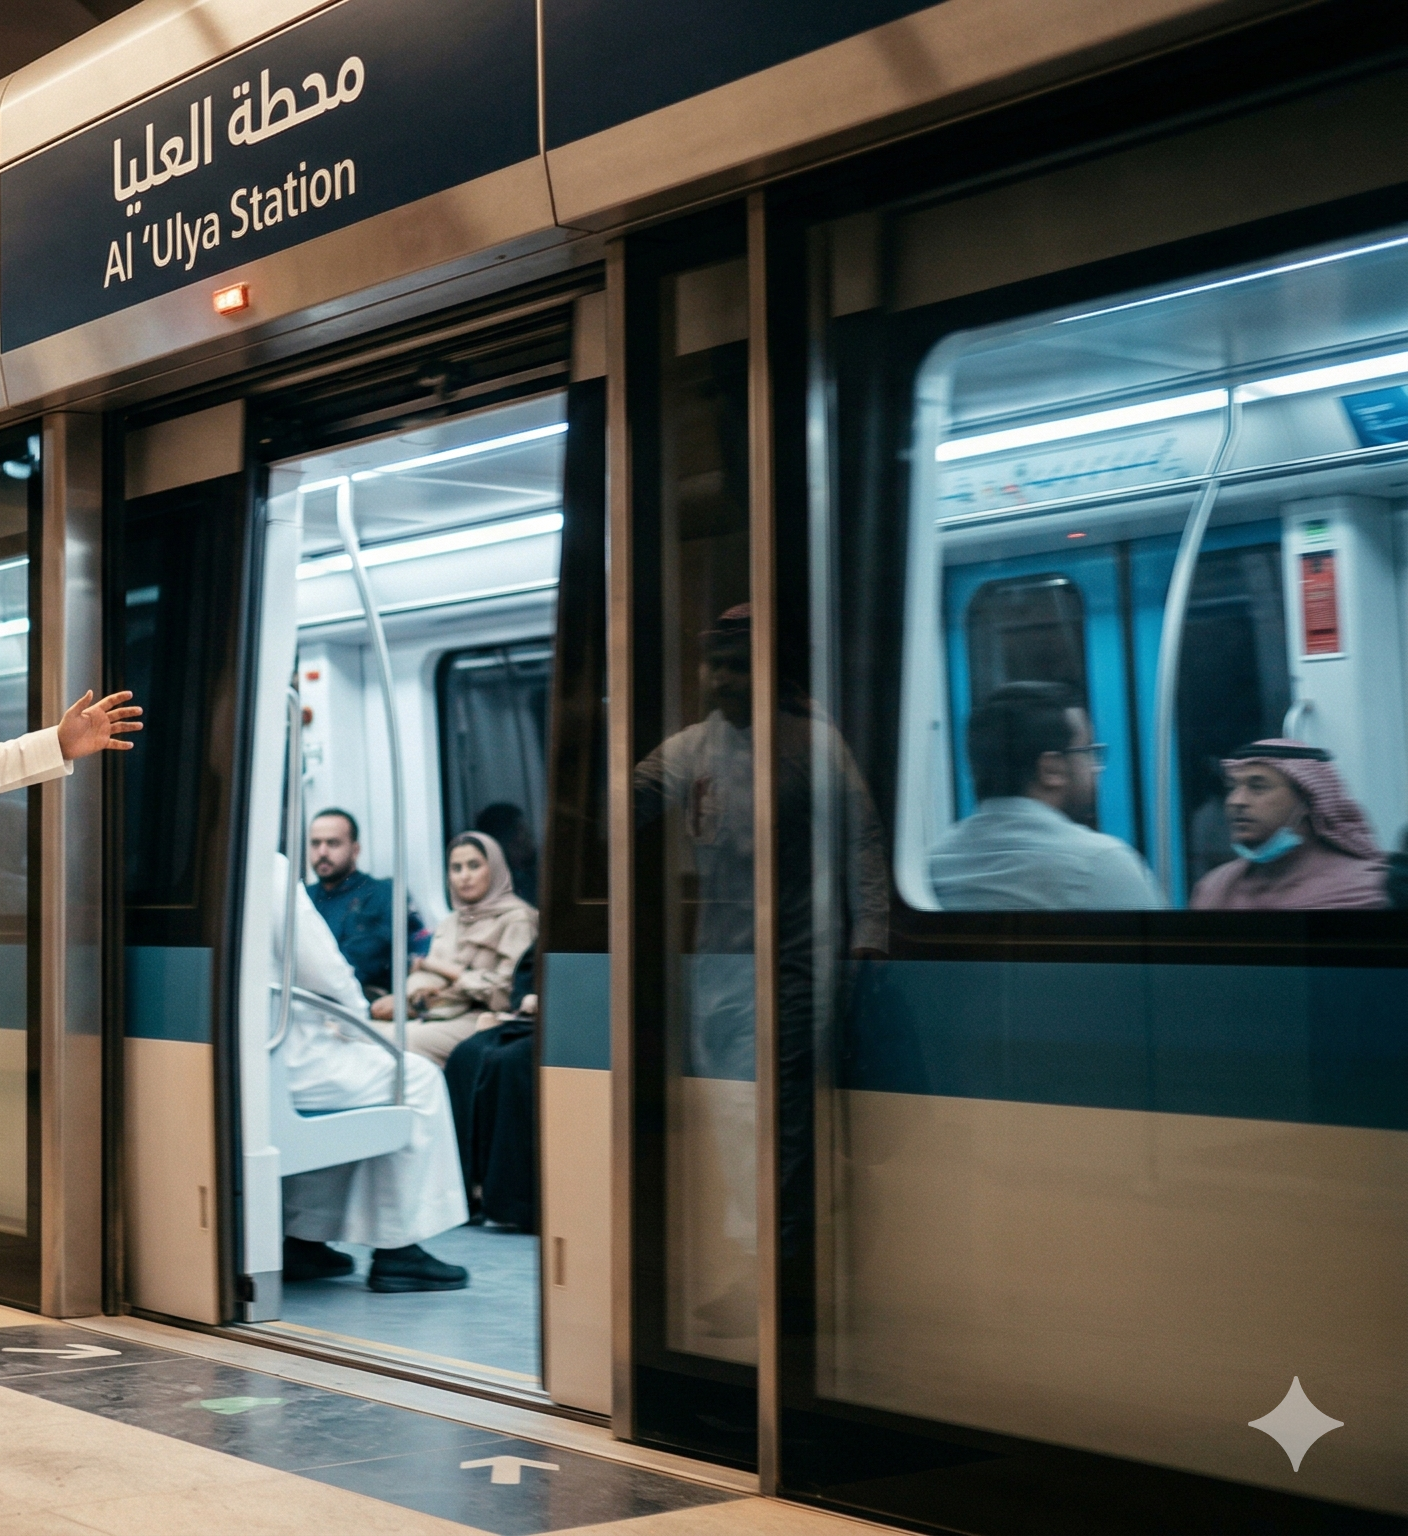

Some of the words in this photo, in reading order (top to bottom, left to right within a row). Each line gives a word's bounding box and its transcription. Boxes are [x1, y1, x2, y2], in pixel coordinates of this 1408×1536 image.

[113, 95, 212, 217] العليا
[228, 56, 365, 146] محطة
[103, 231, 133, 289] Al
[230, 158, 356, 238] Station
